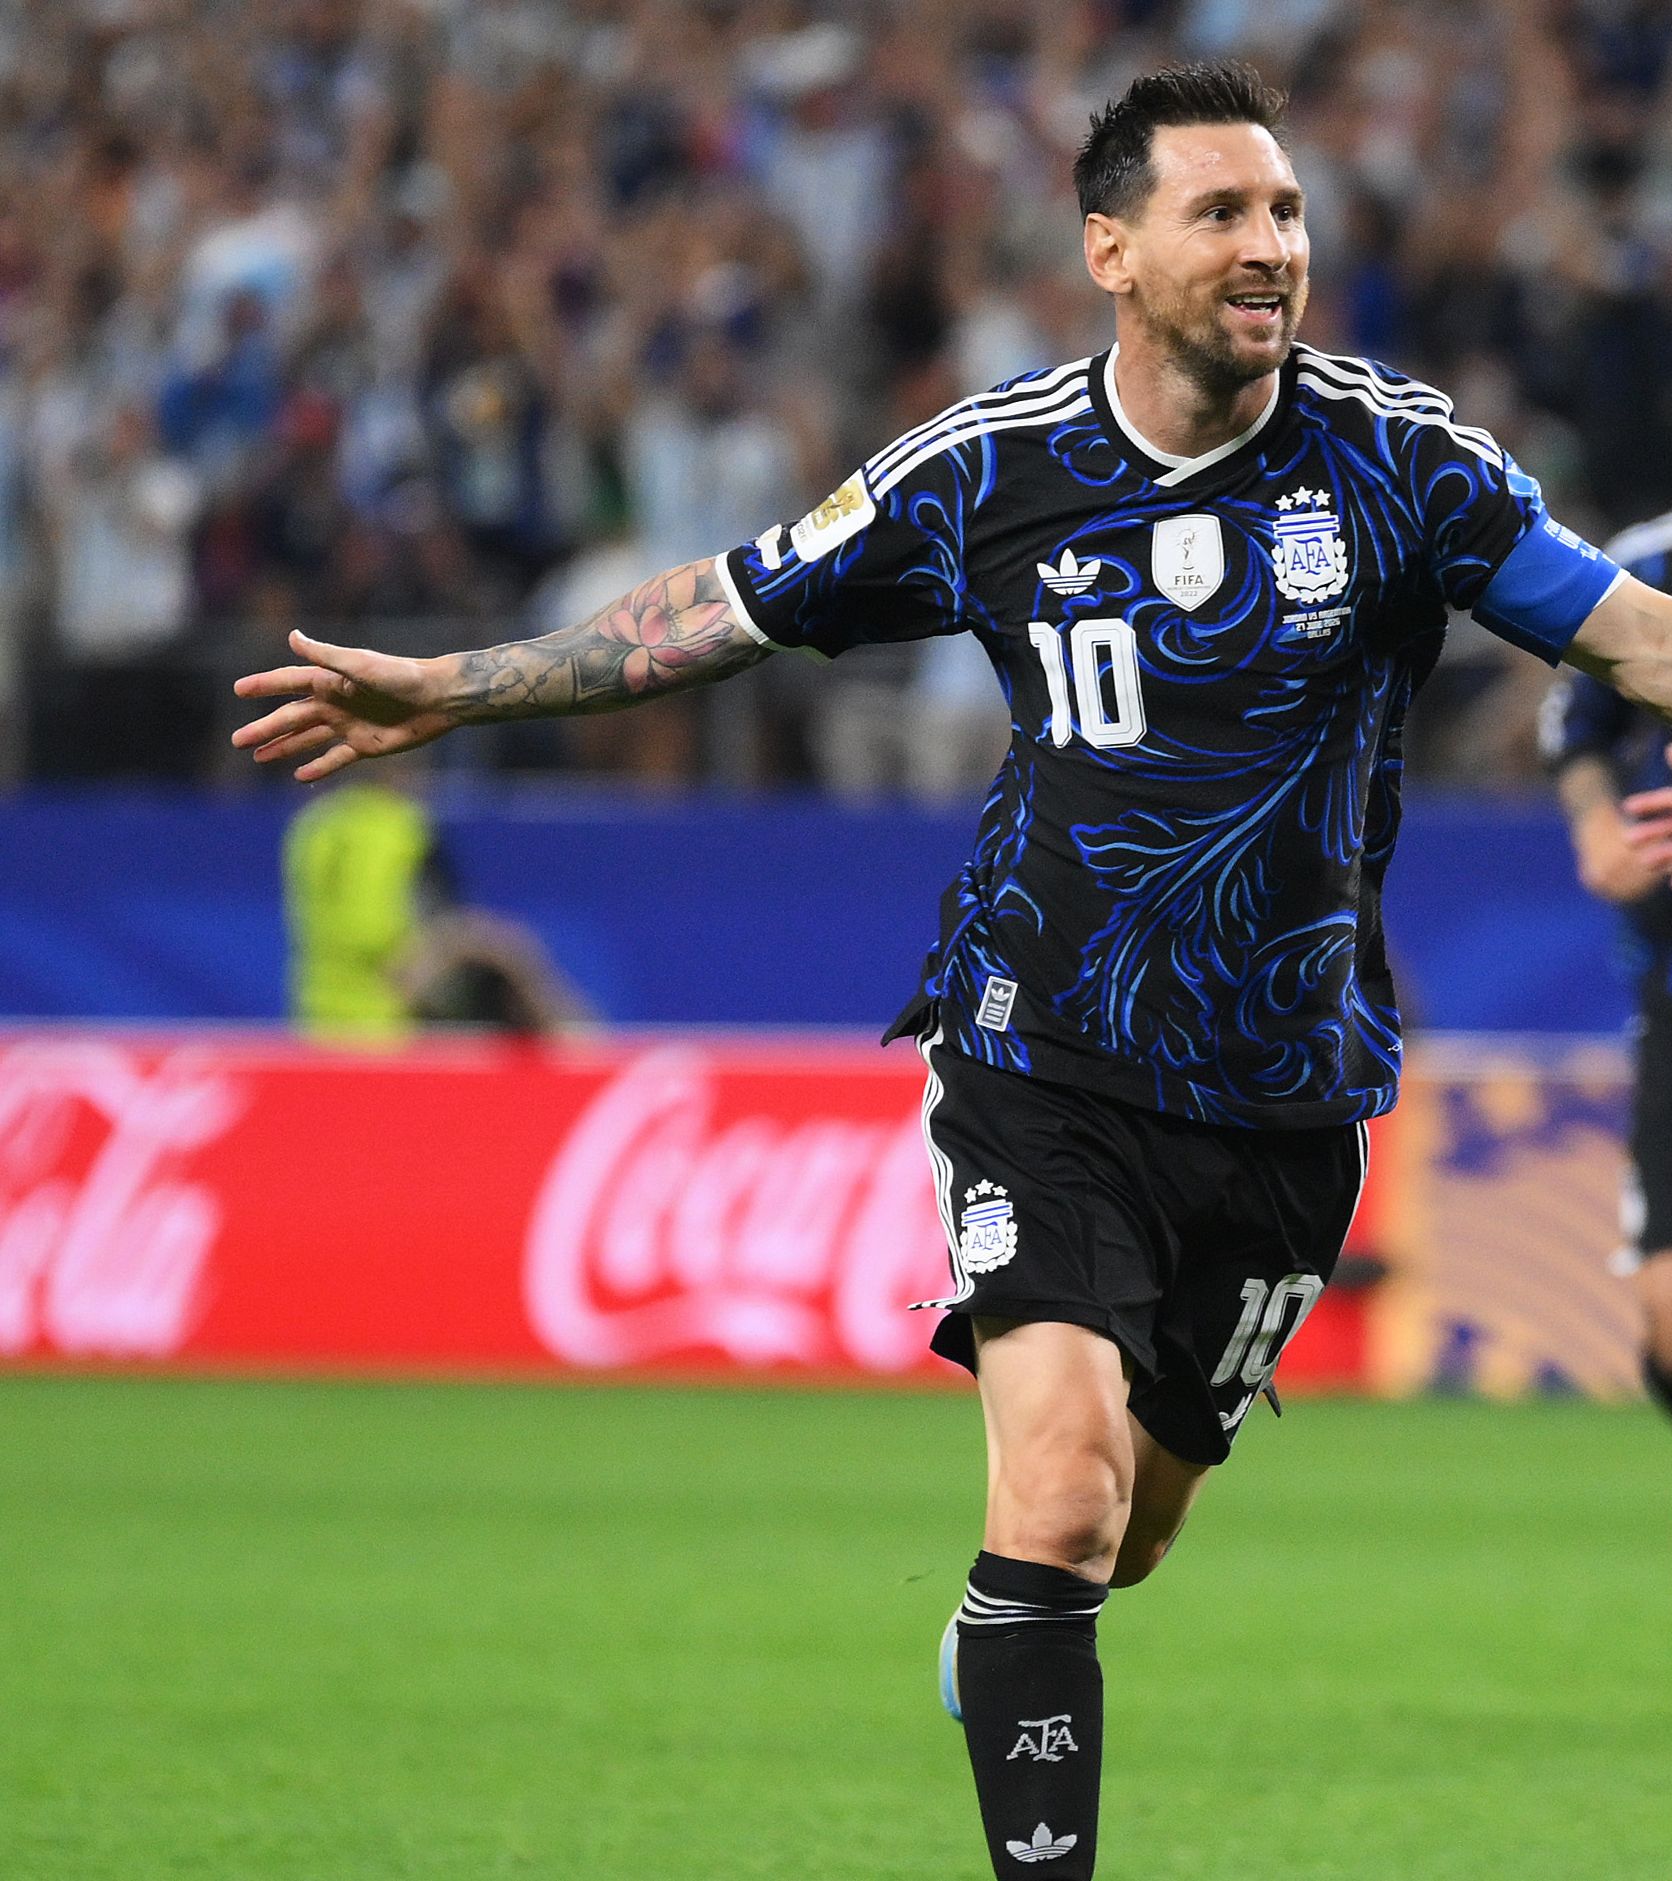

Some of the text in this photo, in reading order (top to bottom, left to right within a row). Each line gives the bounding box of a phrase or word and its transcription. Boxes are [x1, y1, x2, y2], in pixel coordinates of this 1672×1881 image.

[1290, 536, 1332, 576] AFA
[1174, 575, 1204, 586] FIFA
[1027, 617, 1148, 750] 10
[971, 1221, 1002, 1251] AFA
[1210, 1273, 1325, 1387] 10
[1006, 1713, 1078, 1762] AFA
